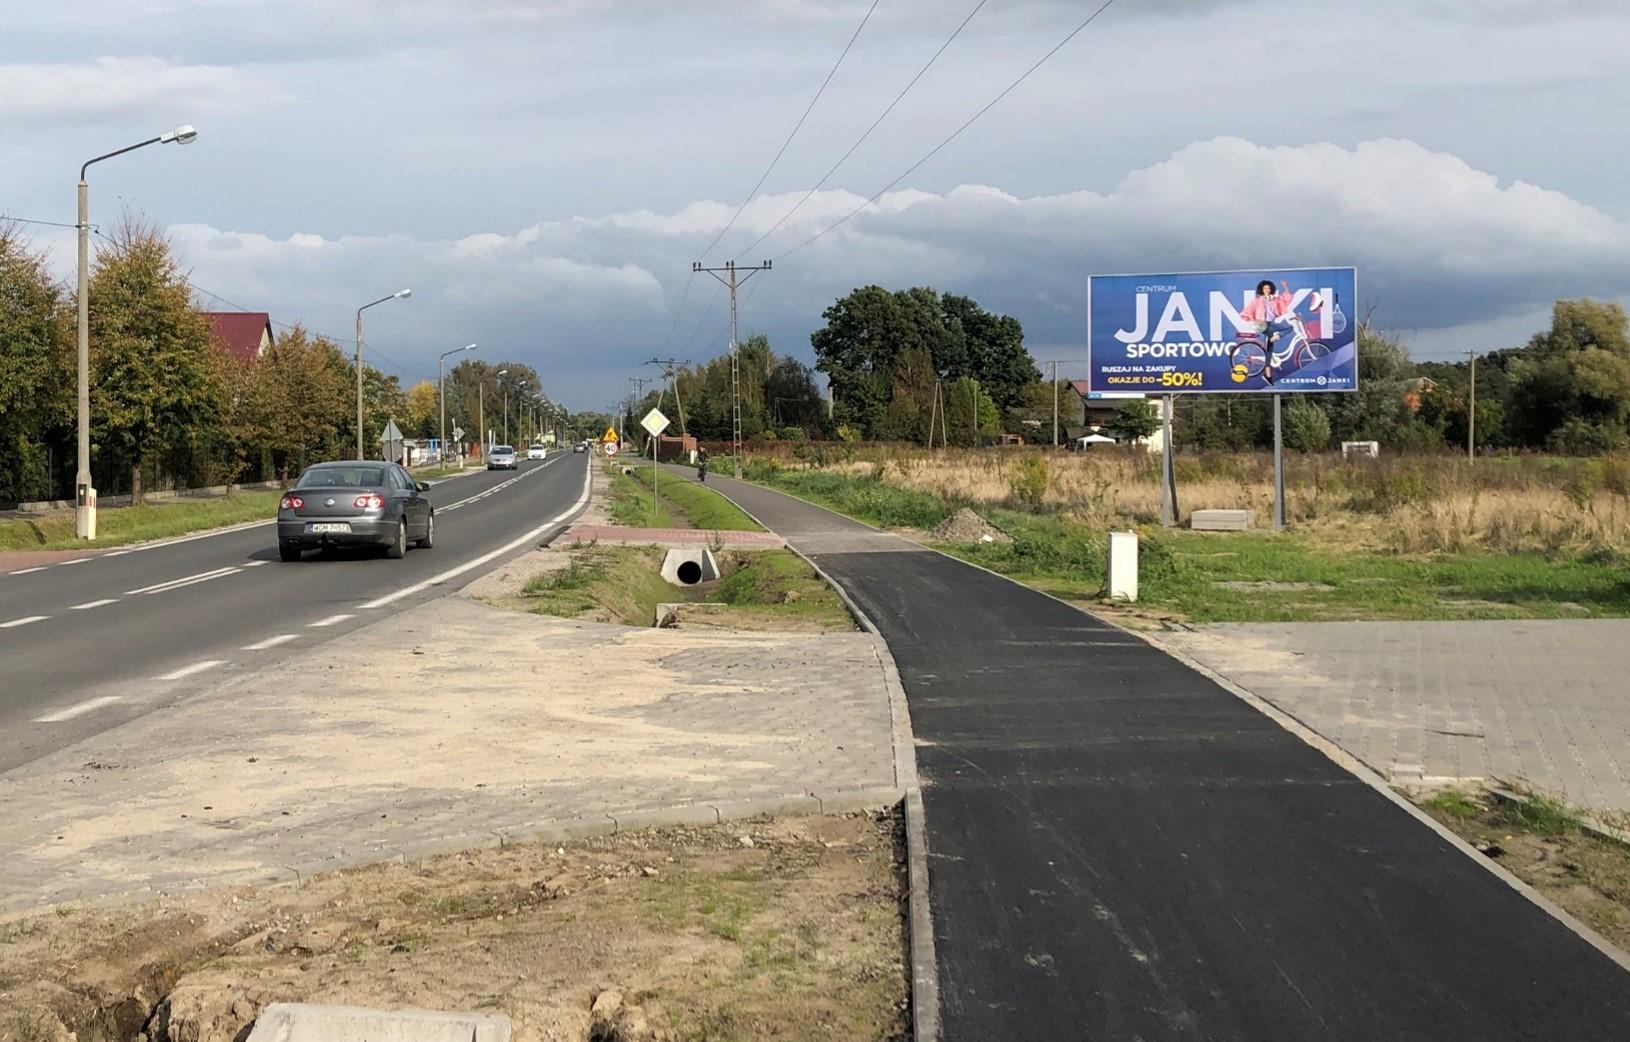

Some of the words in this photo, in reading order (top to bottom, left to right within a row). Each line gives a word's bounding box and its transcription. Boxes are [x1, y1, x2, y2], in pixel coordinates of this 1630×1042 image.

[1135, 285, 1177, 293] CENTRUM
[1107, 376, 1141, 384] OKAZJE
[1156, 372, 1203, 386] -50%!
